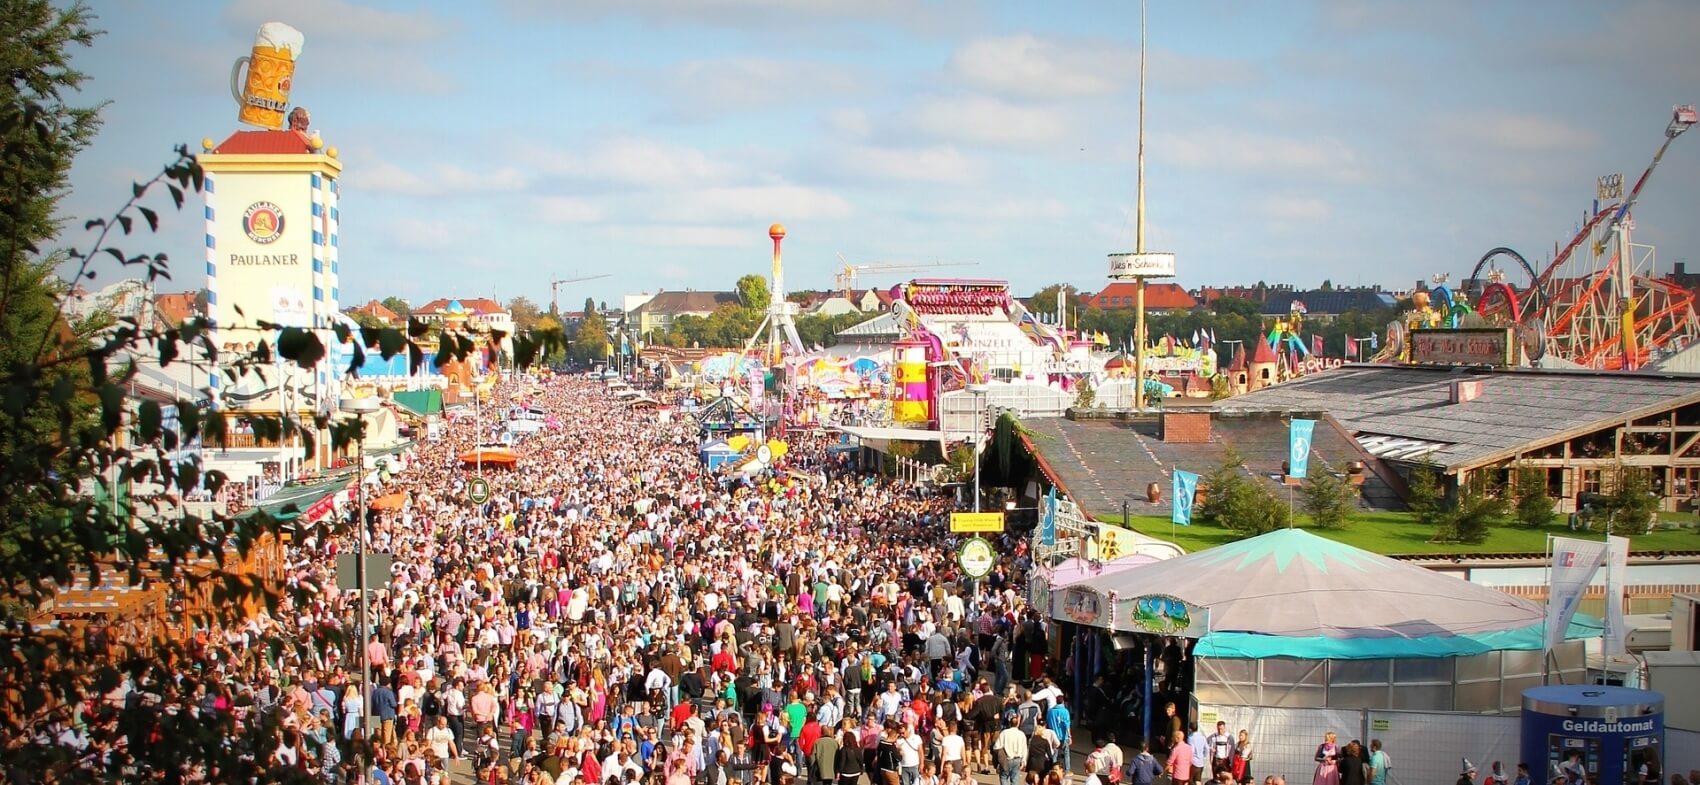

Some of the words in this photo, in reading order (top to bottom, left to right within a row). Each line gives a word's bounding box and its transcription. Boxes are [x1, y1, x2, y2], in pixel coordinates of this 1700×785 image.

[244, 200, 283, 218] PAULANER
[229, 253, 299, 266] PAULANER
[1562, 718, 1655, 733] Geldautomat
